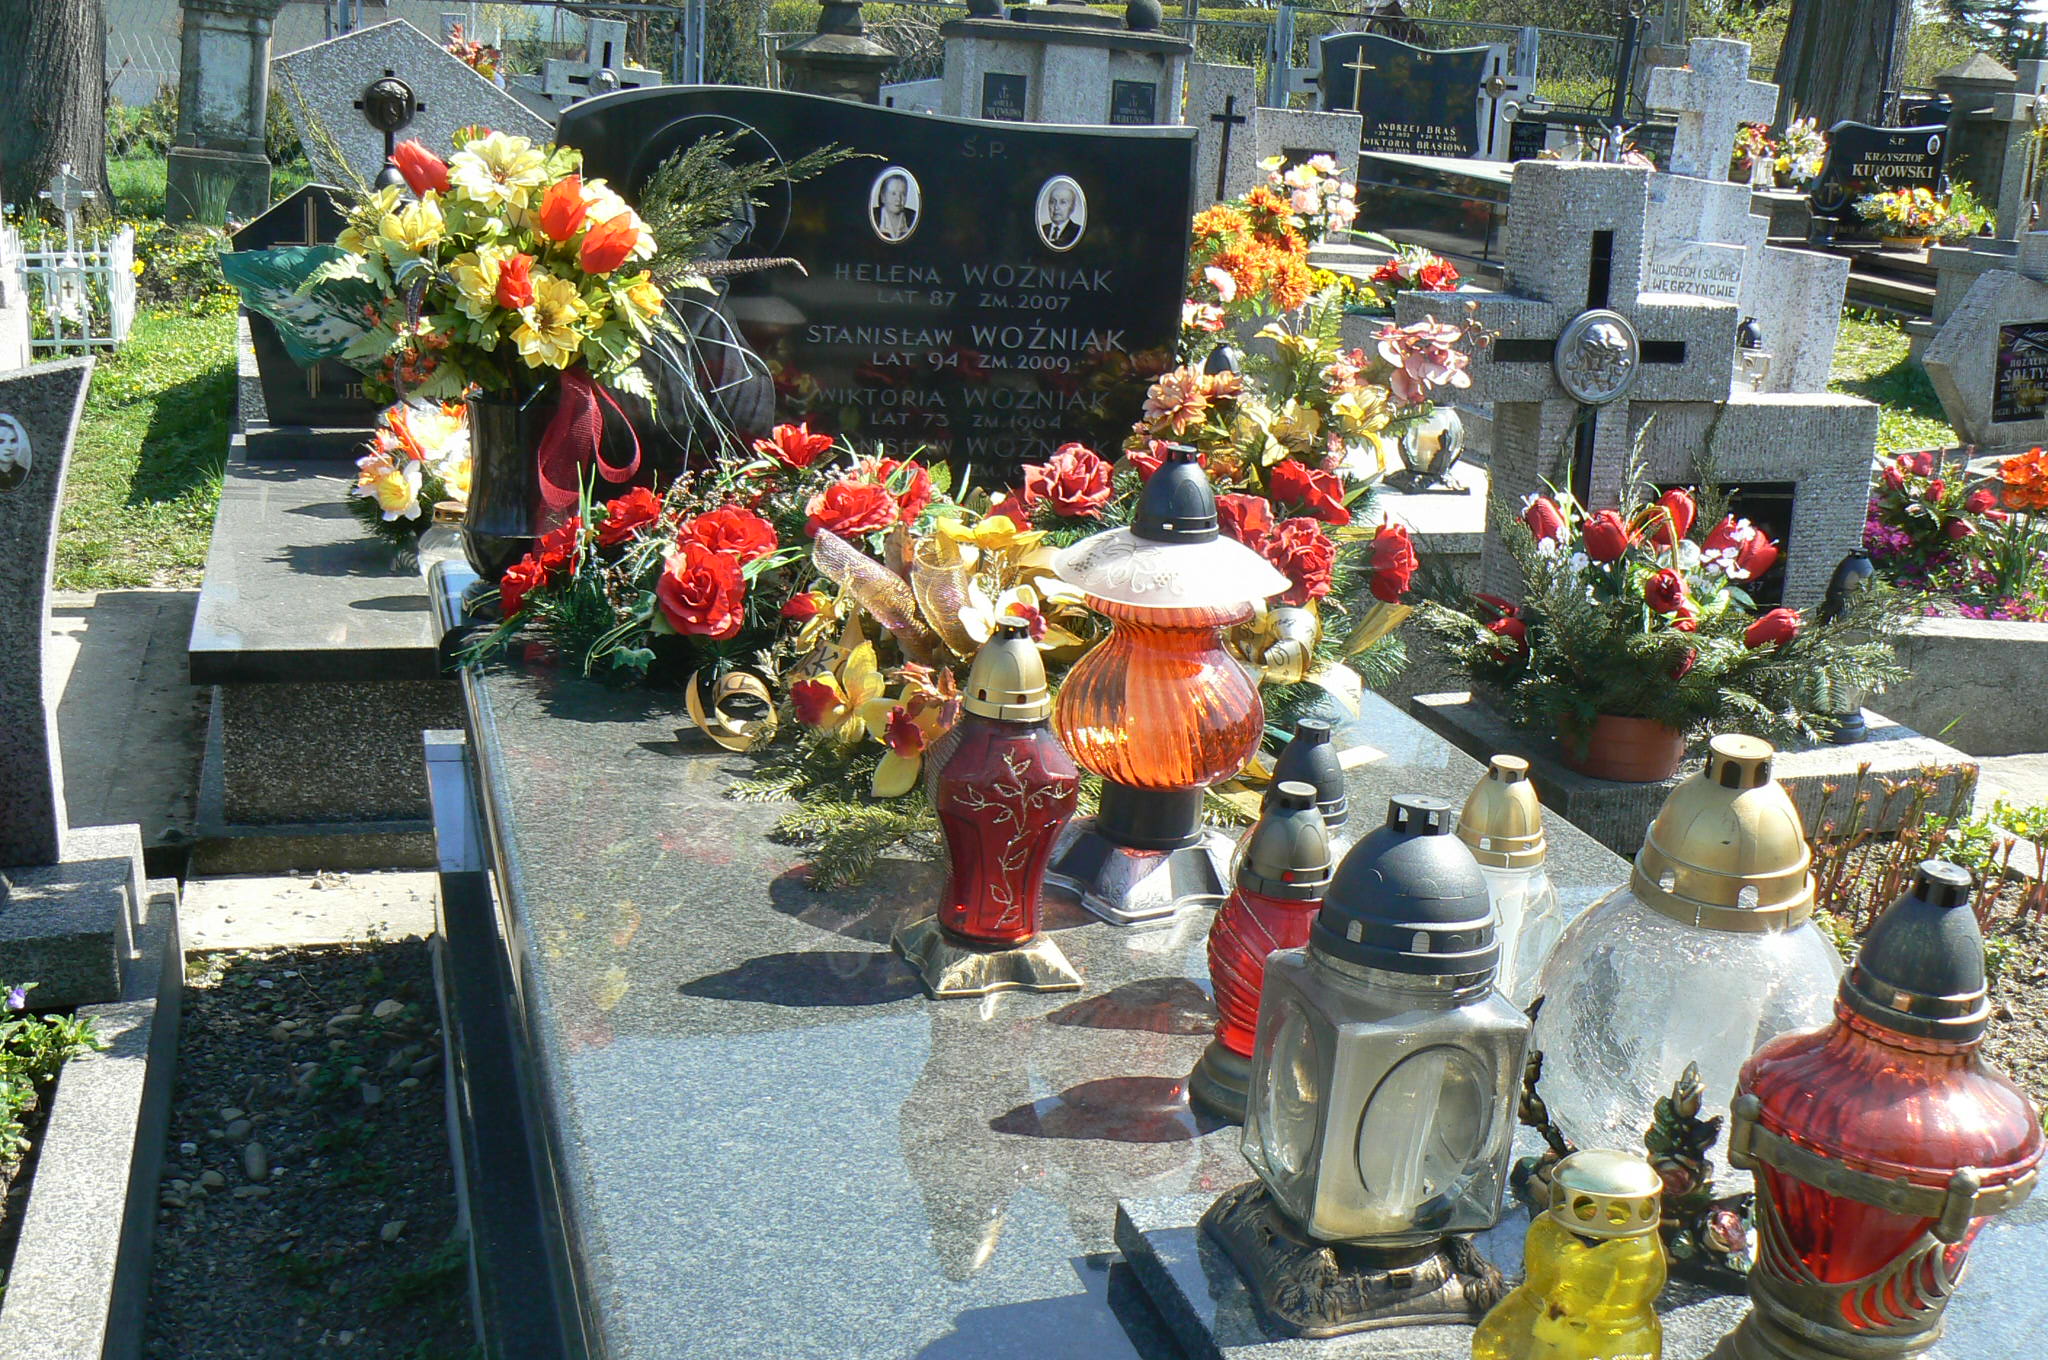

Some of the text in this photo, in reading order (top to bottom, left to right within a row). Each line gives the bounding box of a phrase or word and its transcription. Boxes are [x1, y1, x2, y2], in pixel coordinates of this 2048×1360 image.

[1377, 123, 1420, 133] ANDRZEJ
[1363, 138, 1410, 148] WIKTORIA
[1864, 152, 1925, 162] KRZYSZTOF
[1852, 164, 1934, 178] KUROWSKI
[833, 257, 1114, 293] HELENA WOŹNIAK
[1653, 279, 1736, 297] WĘGRZYNOWIE
[877, 289, 919, 304] LAT
[929, 289, 958, 307] 87
[805, 317, 1127, 354] STANISŁAW WOŹNIAK
[872, 351, 916, 367] LAT
[927, 351, 959, 373] 94
[817, 387, 947, 408] WIKTORIA
[871, 412, 911, 426] LAT
[965, 432, 1113, 460] WOŹNK
